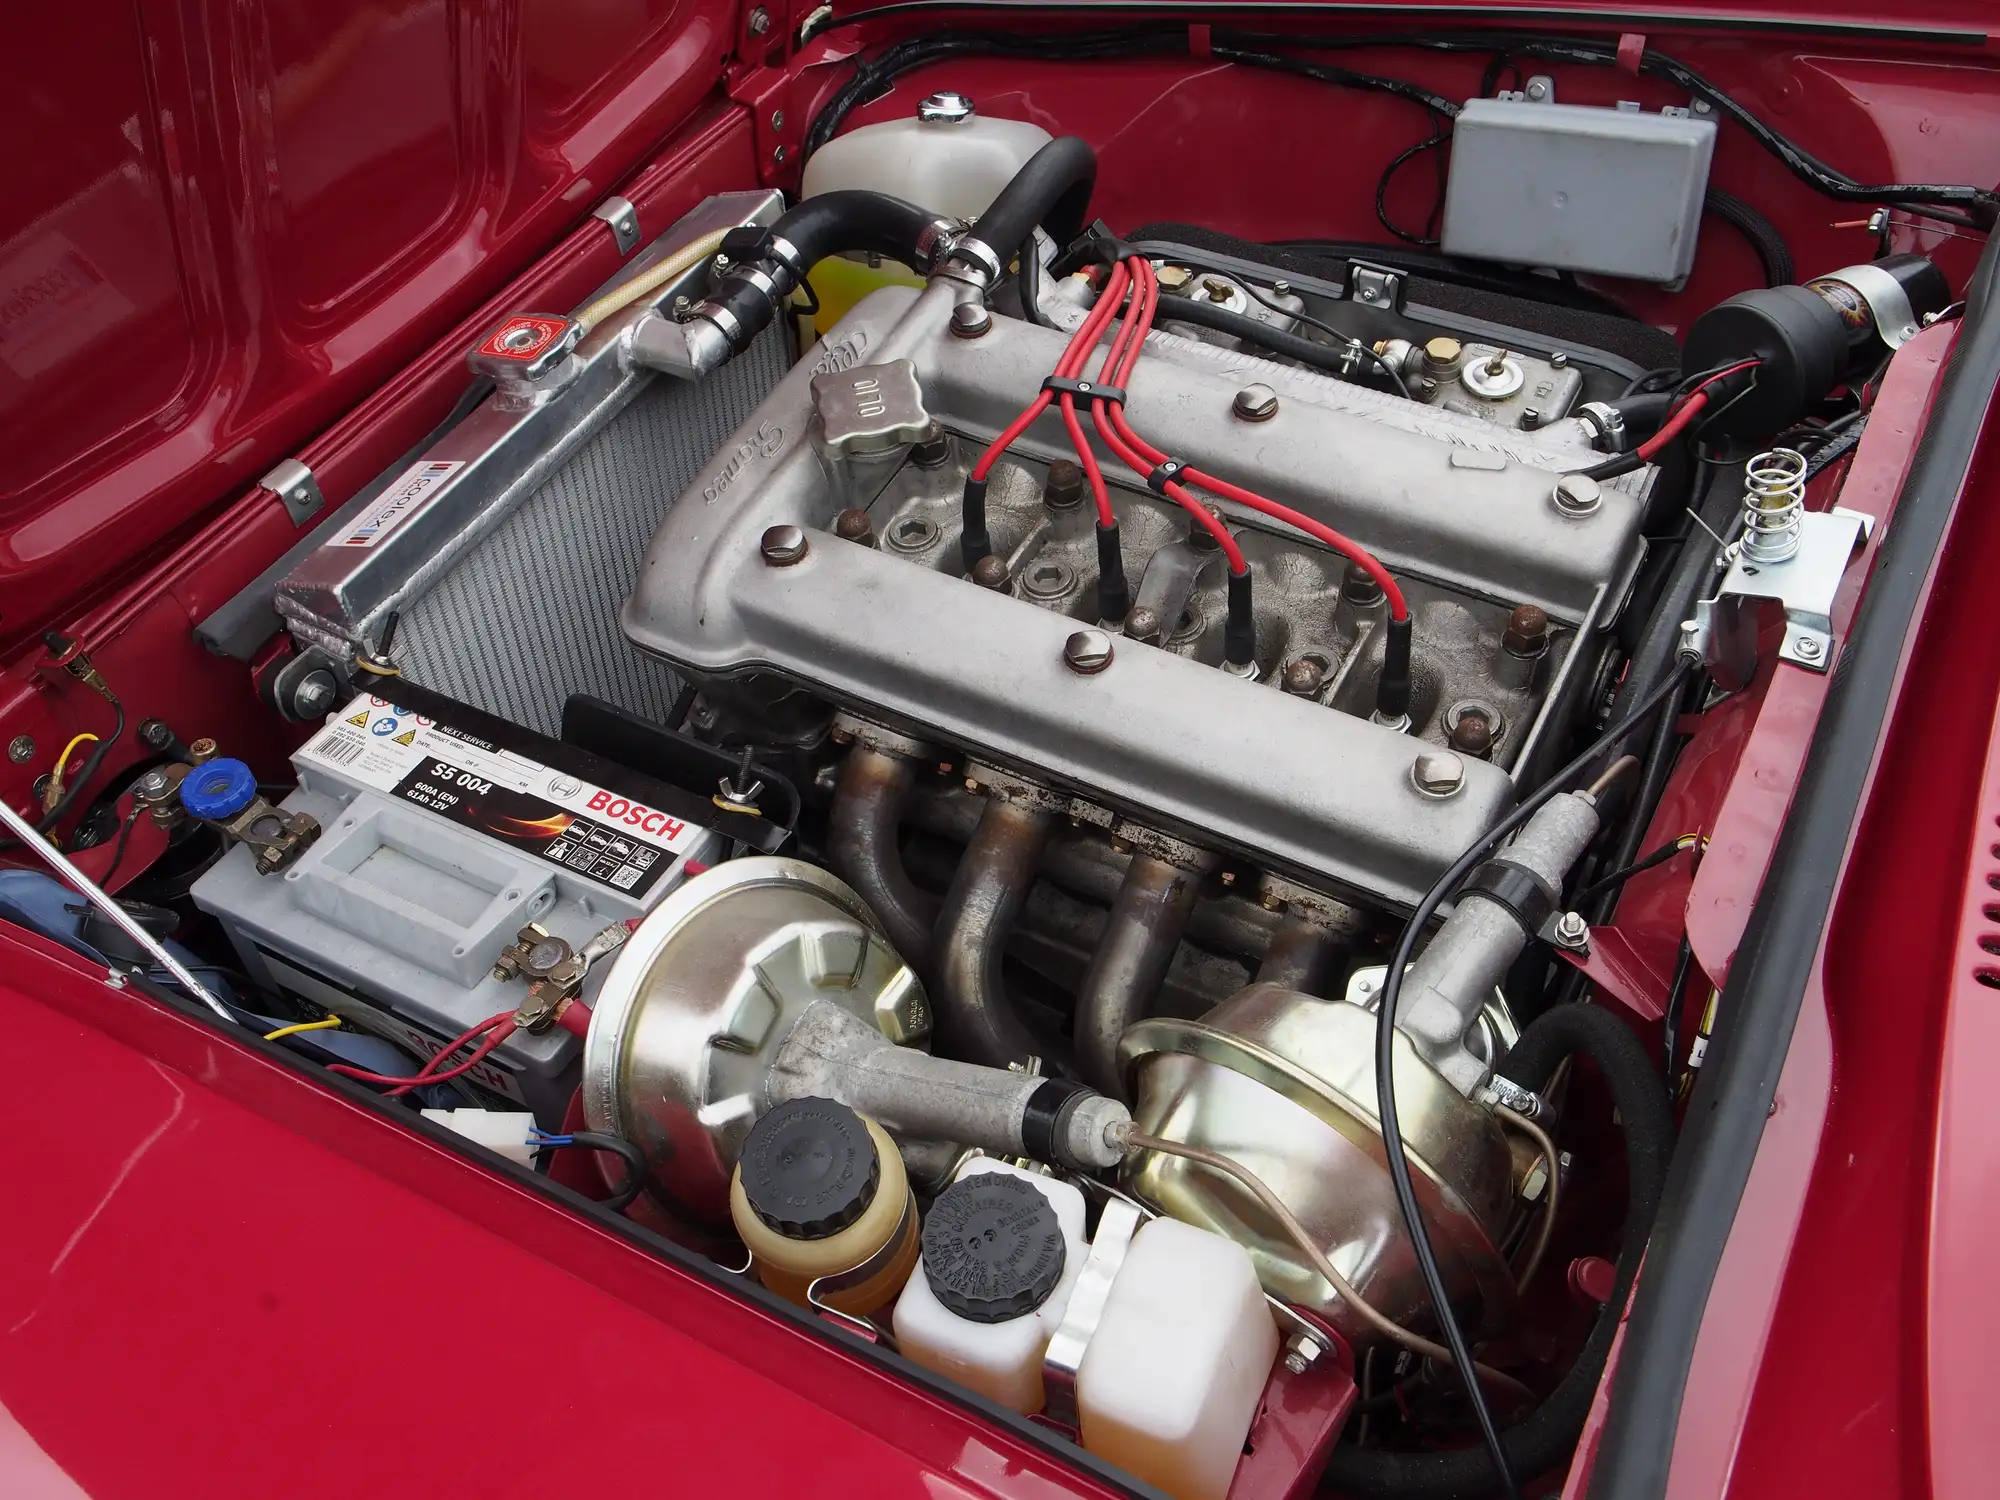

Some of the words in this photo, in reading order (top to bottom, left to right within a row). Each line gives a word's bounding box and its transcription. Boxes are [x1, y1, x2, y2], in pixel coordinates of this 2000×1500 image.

[852, 379, 886, 418] OLIO
[702, 419, 786, 507] Romeo
[369, 478, 431, 529] coolex
[416, 740, 431, 749] DATE:
[465, 759, 474, 767] OR
[425, 732, 449, 745] PRODUCT
[449, 740, 465, 751] USED:
[440, 725, 464, 739] NEXT
[462, 733, 494, 751] SERVICE
[414, 781, 439, 797] 600A
[437, 790, 460, 805] (EN)
[430, 763, 456, 781] S5
[456, 773, 493, 796] 004
[406, 789, 430, 804] 61Ah
[430, 799, 450, 811] 12V
[585, 790, 686, 842] BOSCH
[931, 1187, 963, 1227] BEFORE
[965, 1175, 1029, 1195] REMOVING
